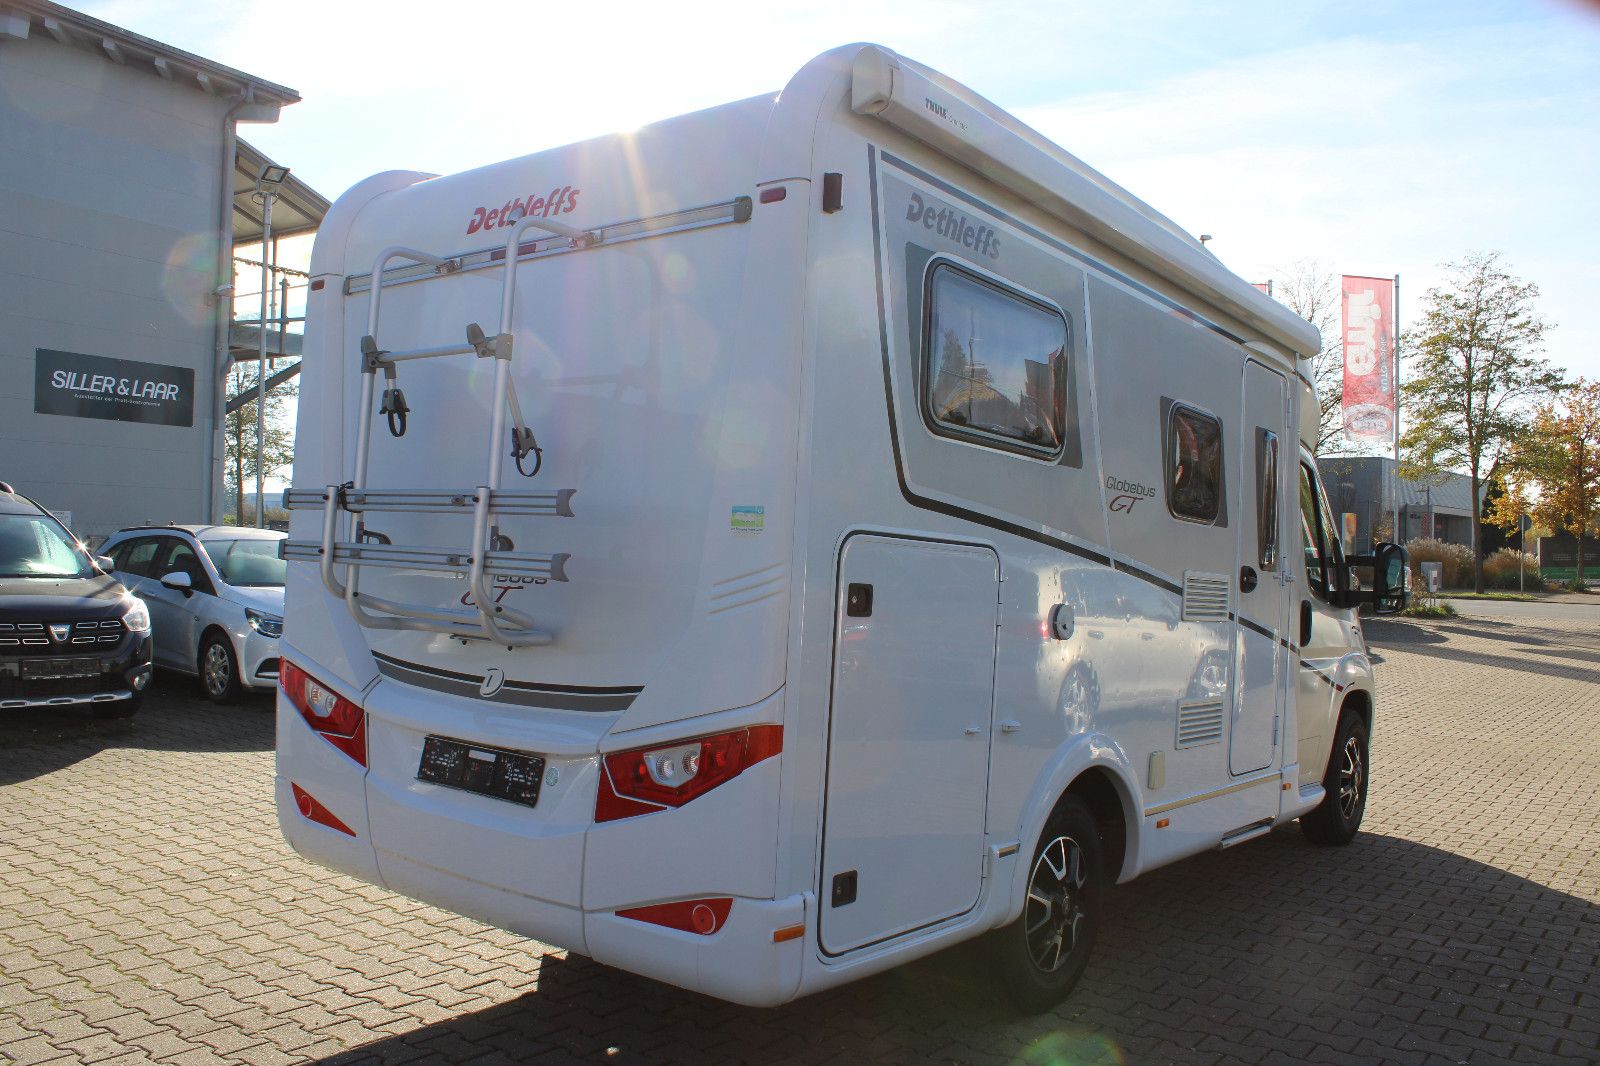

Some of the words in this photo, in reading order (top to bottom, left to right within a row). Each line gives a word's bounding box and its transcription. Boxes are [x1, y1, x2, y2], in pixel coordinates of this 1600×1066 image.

[466, 185, 581, 235] Dethleffs
[905, 192, 1001, 260] Dethleffs
[51, 370, 116, 394] SILLER
[117, 378, 129, 396] &
[131, 379, 179, 401] LAAR
[1106, 476, 1156, 497] Globebus
[1109, 495, 1144, 515] GT
